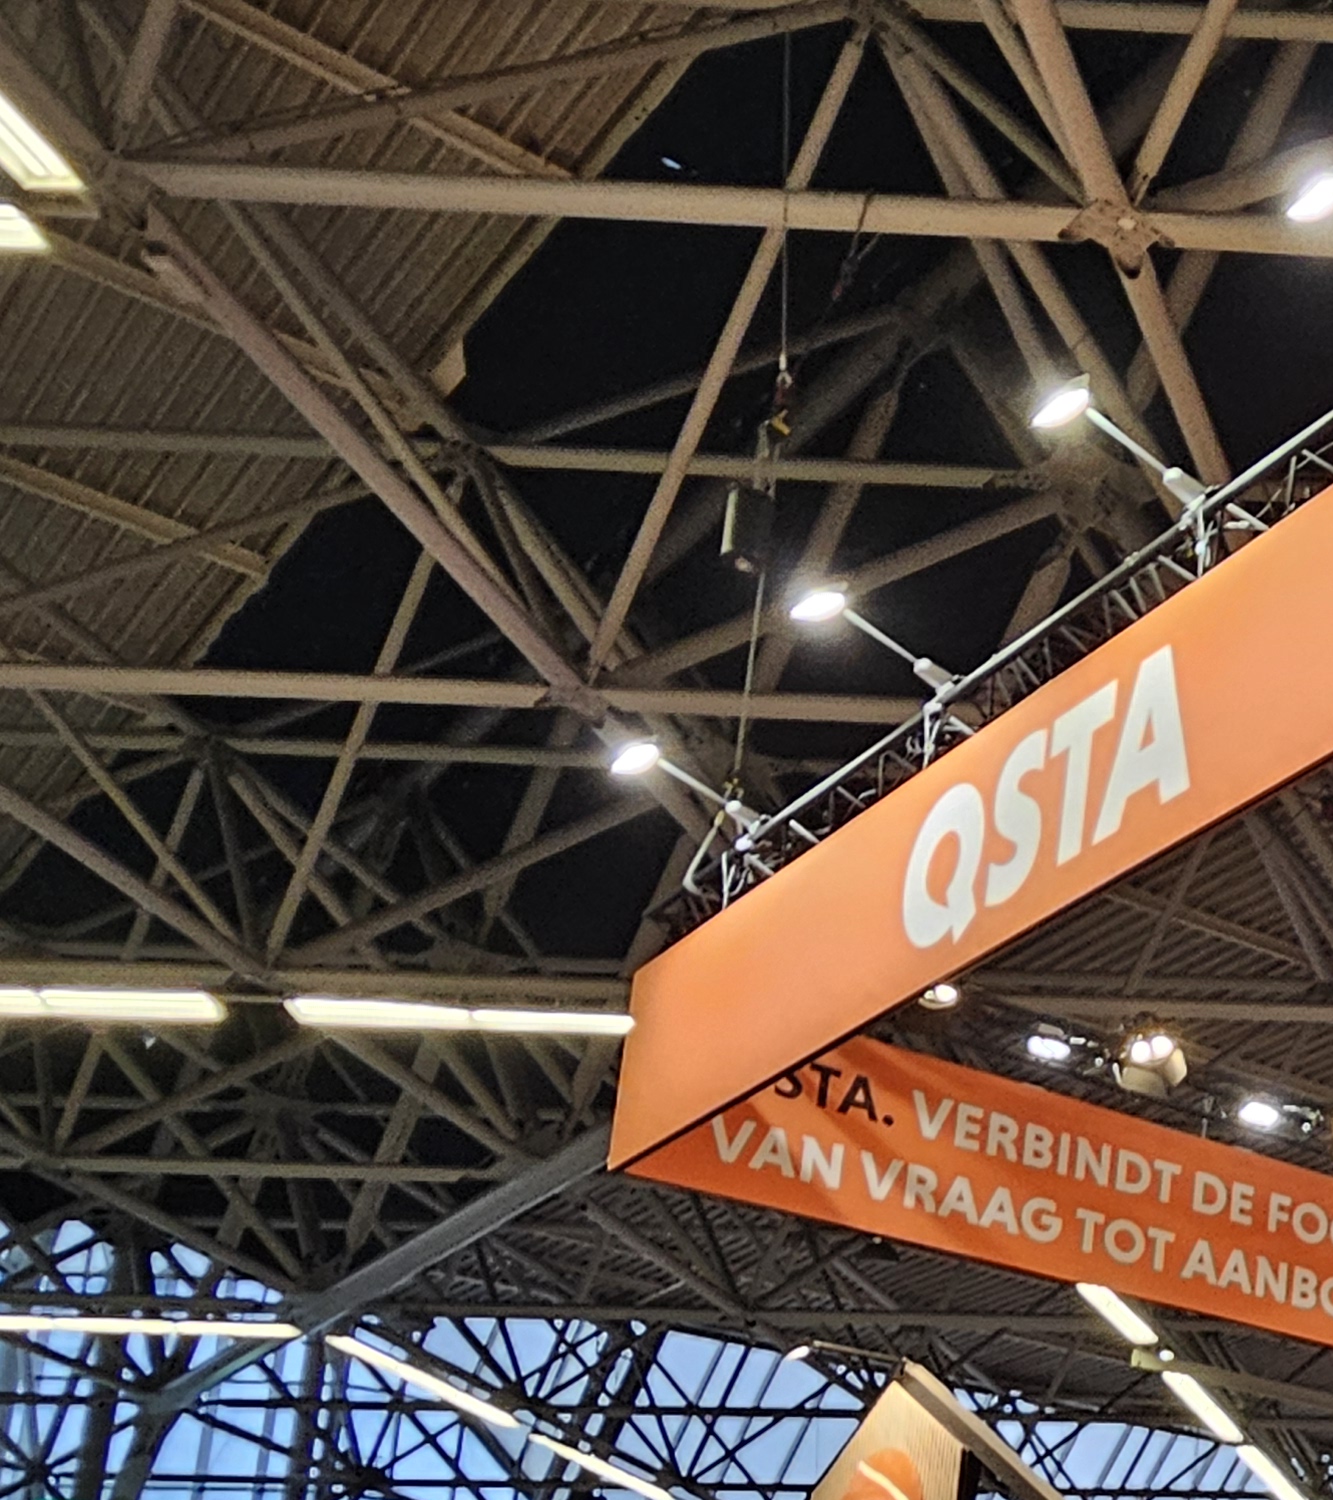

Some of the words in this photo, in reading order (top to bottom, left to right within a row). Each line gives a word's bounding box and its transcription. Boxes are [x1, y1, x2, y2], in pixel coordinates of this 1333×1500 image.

[902, 643, 1191, 949] QSTA
[709, 1114, 845, 1191] VAN
[860, 1150, 1064, 1244] VRAAG
[1075, 1207, 1176, 1273] TOT
[774, 1062, 895, 1127] STA.
[911, 1088, 1182, 1204] VERBINDT
[1192, 1170, 1255, 1226] DE
